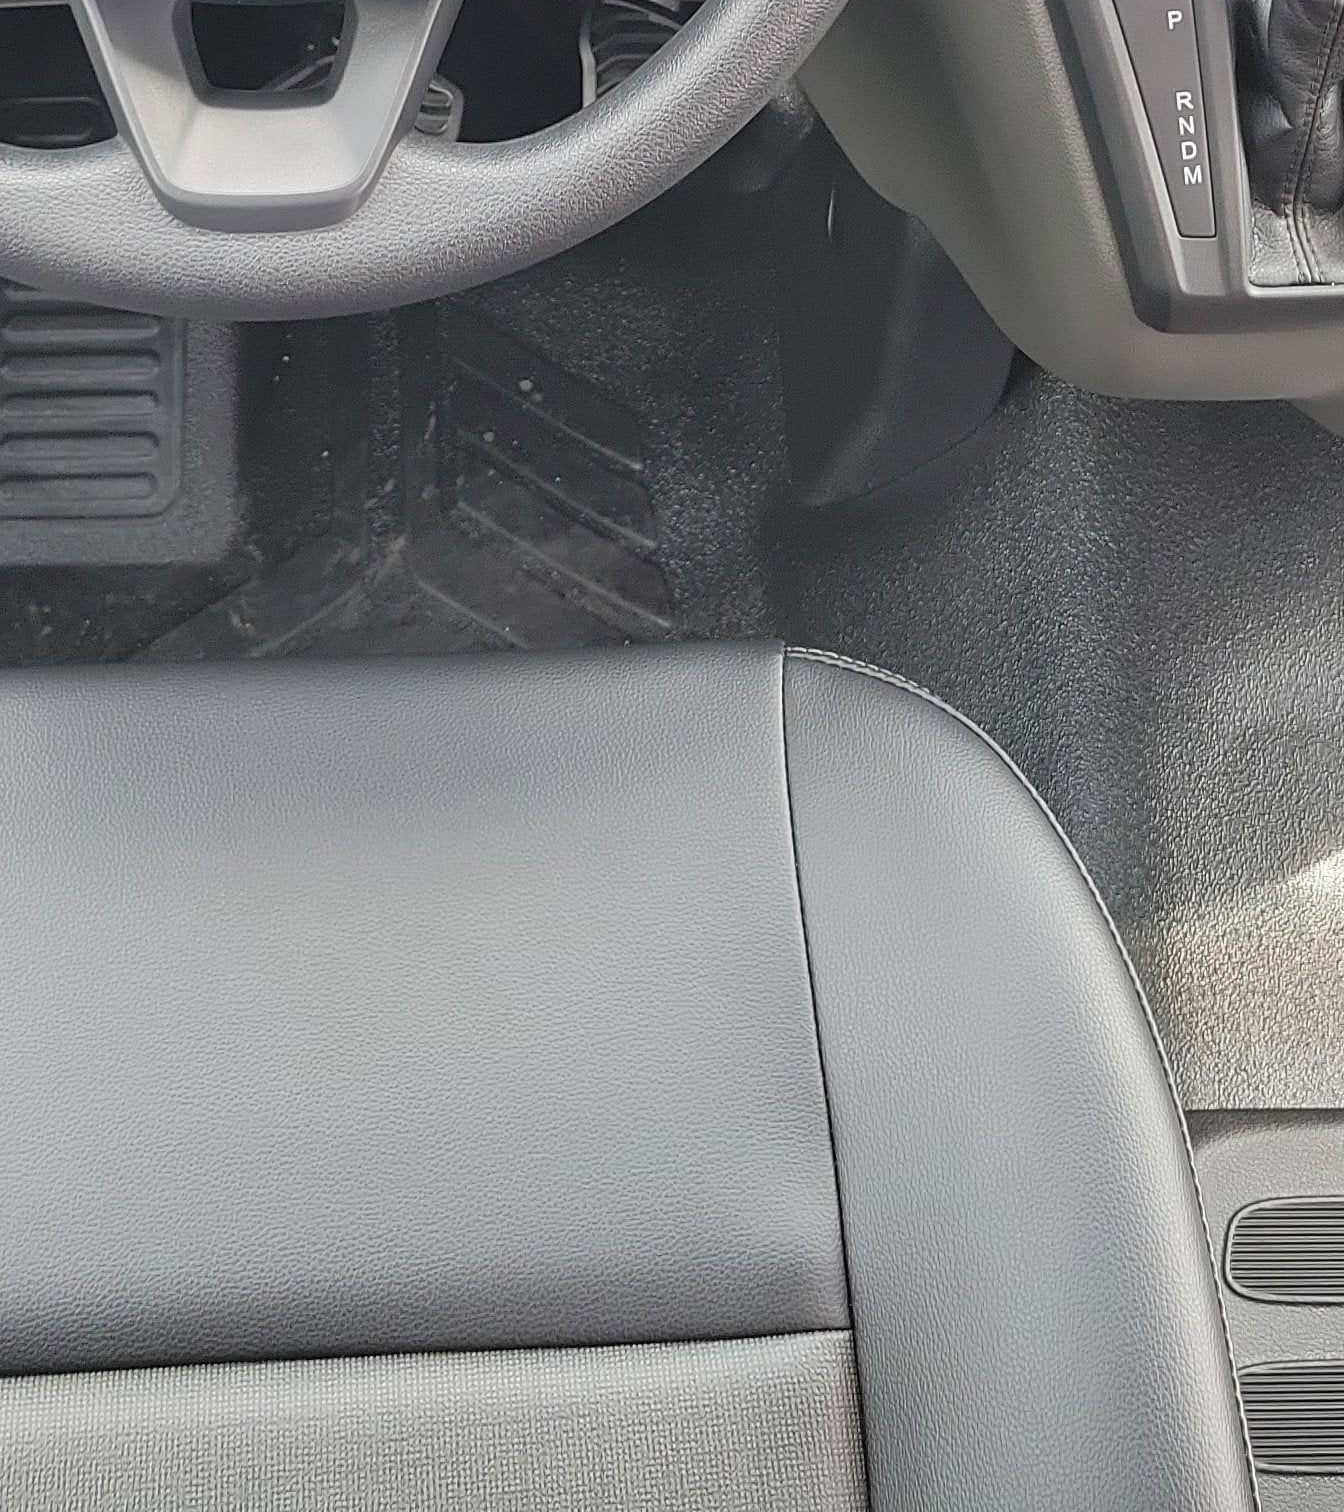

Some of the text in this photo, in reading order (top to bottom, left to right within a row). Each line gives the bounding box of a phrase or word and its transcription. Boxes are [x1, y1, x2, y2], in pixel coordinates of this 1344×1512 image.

[1167, 10, 1183, 30] P
[1176, 91, 1194, 111] R
[1178, 115, 1196, 136] N
[1181, 141, 1197, 160] D
[1183, 165, 1203, 186] M
